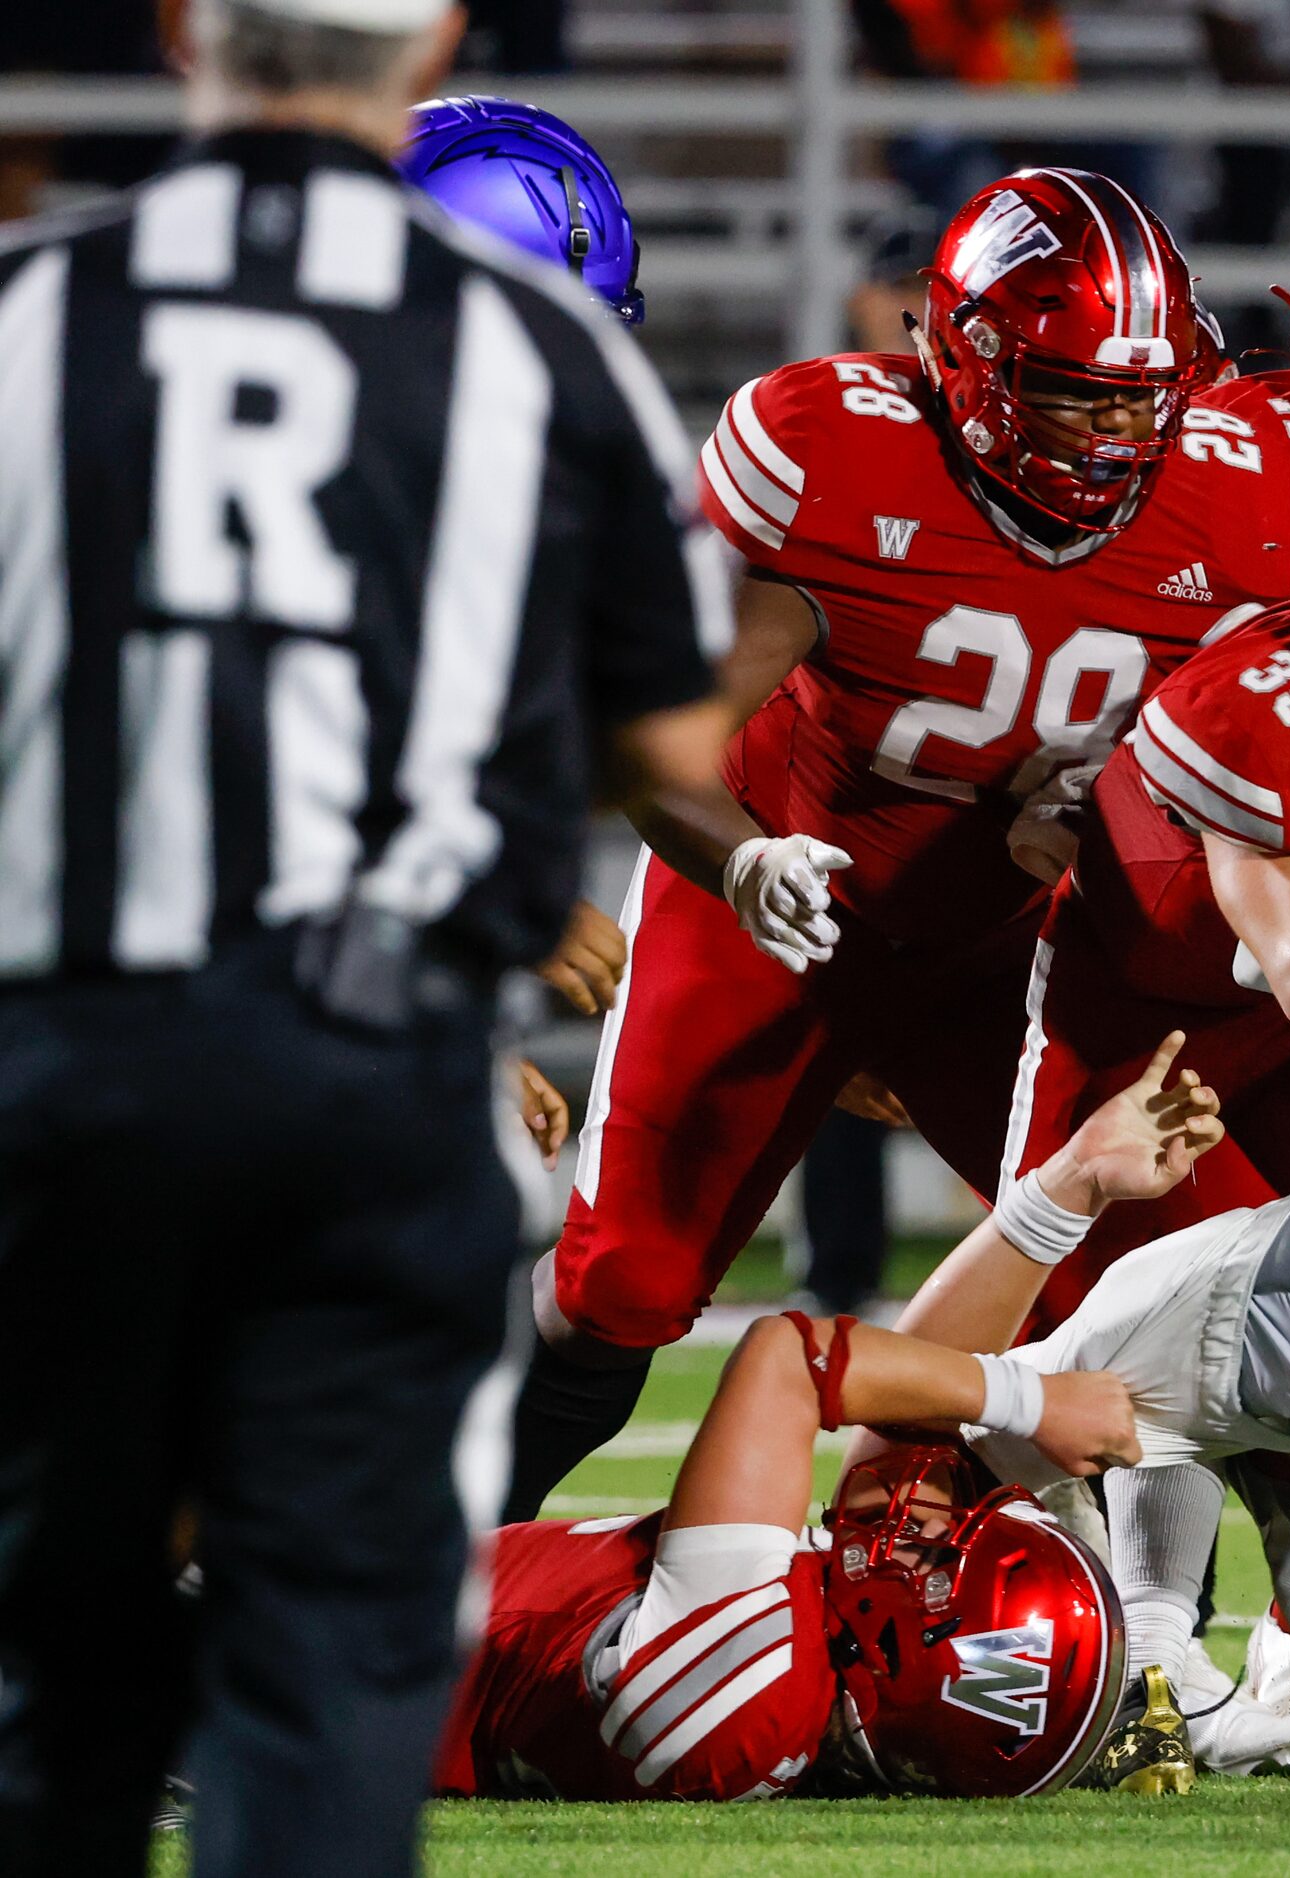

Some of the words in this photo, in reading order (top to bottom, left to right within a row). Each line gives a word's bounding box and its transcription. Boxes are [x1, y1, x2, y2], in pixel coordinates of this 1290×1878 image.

[951, 189, 1063, 299] W
[832, 362, 921, 424] 28
[140, 299, 358, 632] R
[1182, 407, 1263, 475] 28
[873, 514, 920, 561] W
[1157, 582, 1213, 602] adidas
[870, 603, 1150, 803] 28
[941, 1618, 1055, 1737] W
